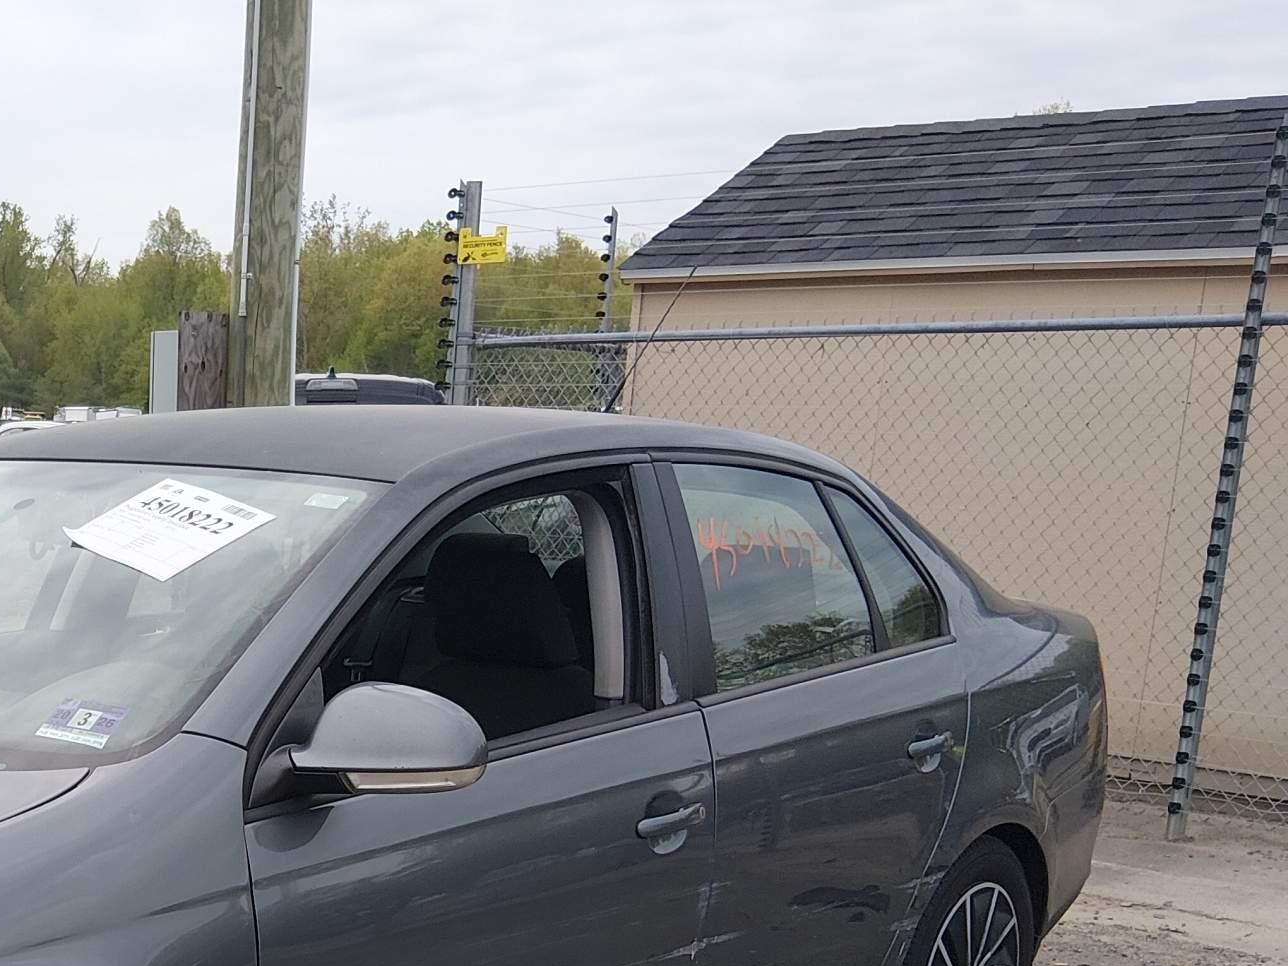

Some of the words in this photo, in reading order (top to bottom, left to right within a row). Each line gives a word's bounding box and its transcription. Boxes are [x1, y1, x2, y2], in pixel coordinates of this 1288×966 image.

[140, 496, 234, 534] 45018222
[77, 712, 92, 726] 3
[97, 717, 116, 728] 26
